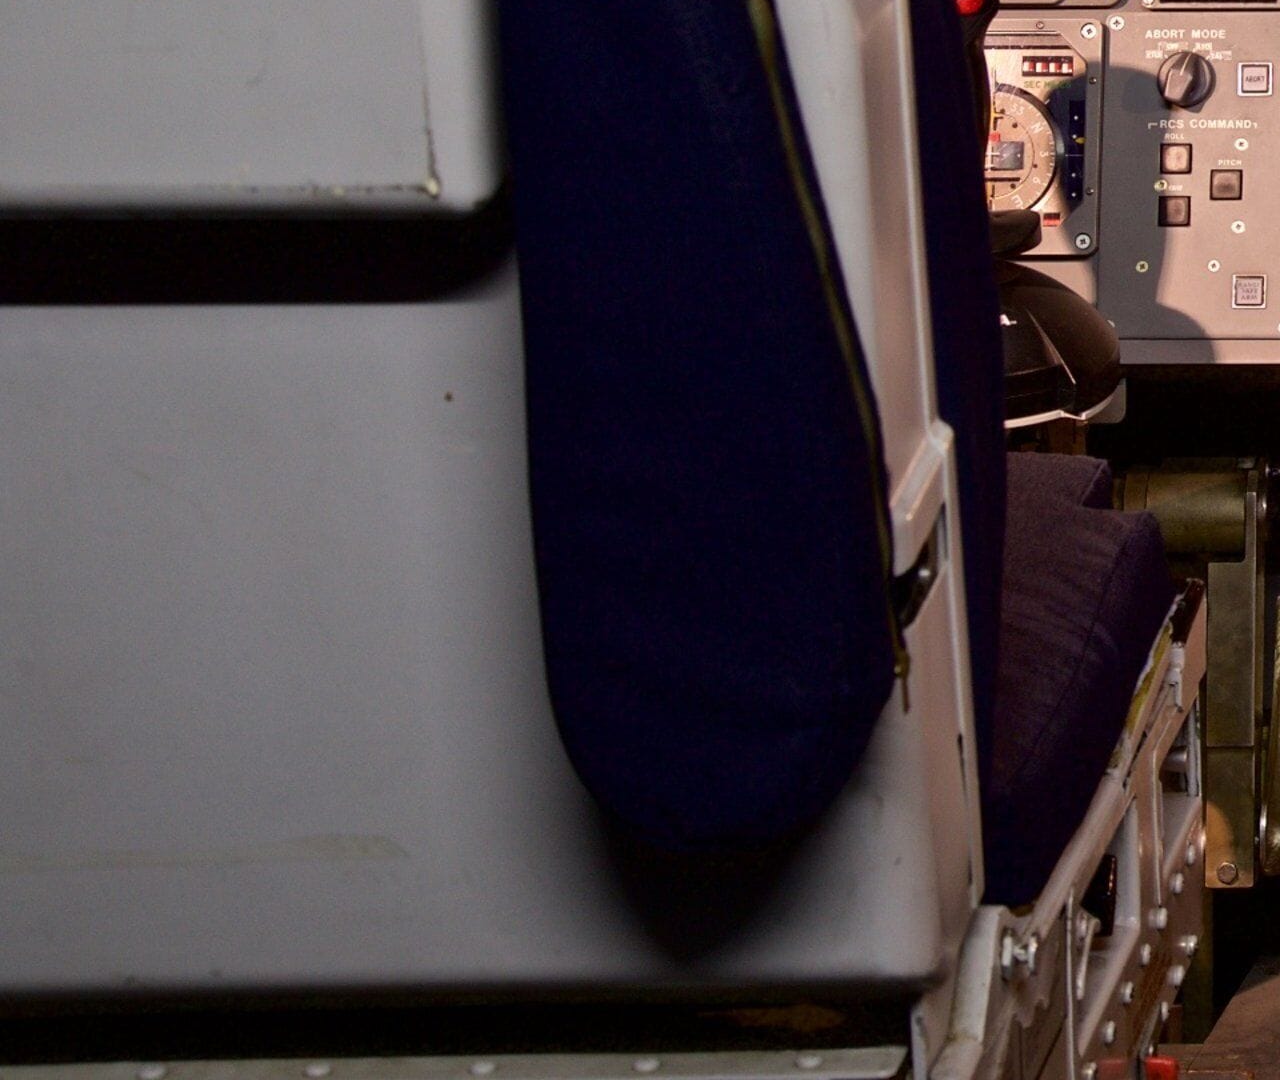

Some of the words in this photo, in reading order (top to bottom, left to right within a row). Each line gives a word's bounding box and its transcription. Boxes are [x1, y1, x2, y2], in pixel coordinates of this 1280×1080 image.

[1145, 29, 1186, 39] ABORT
[1191, 29, 1227, 39] MODE
[1159, 119, 1185, 129] RCS
[1189, 119, 1252, 129] COMMAND
[1218, 159, 1242, 167] PITCH
